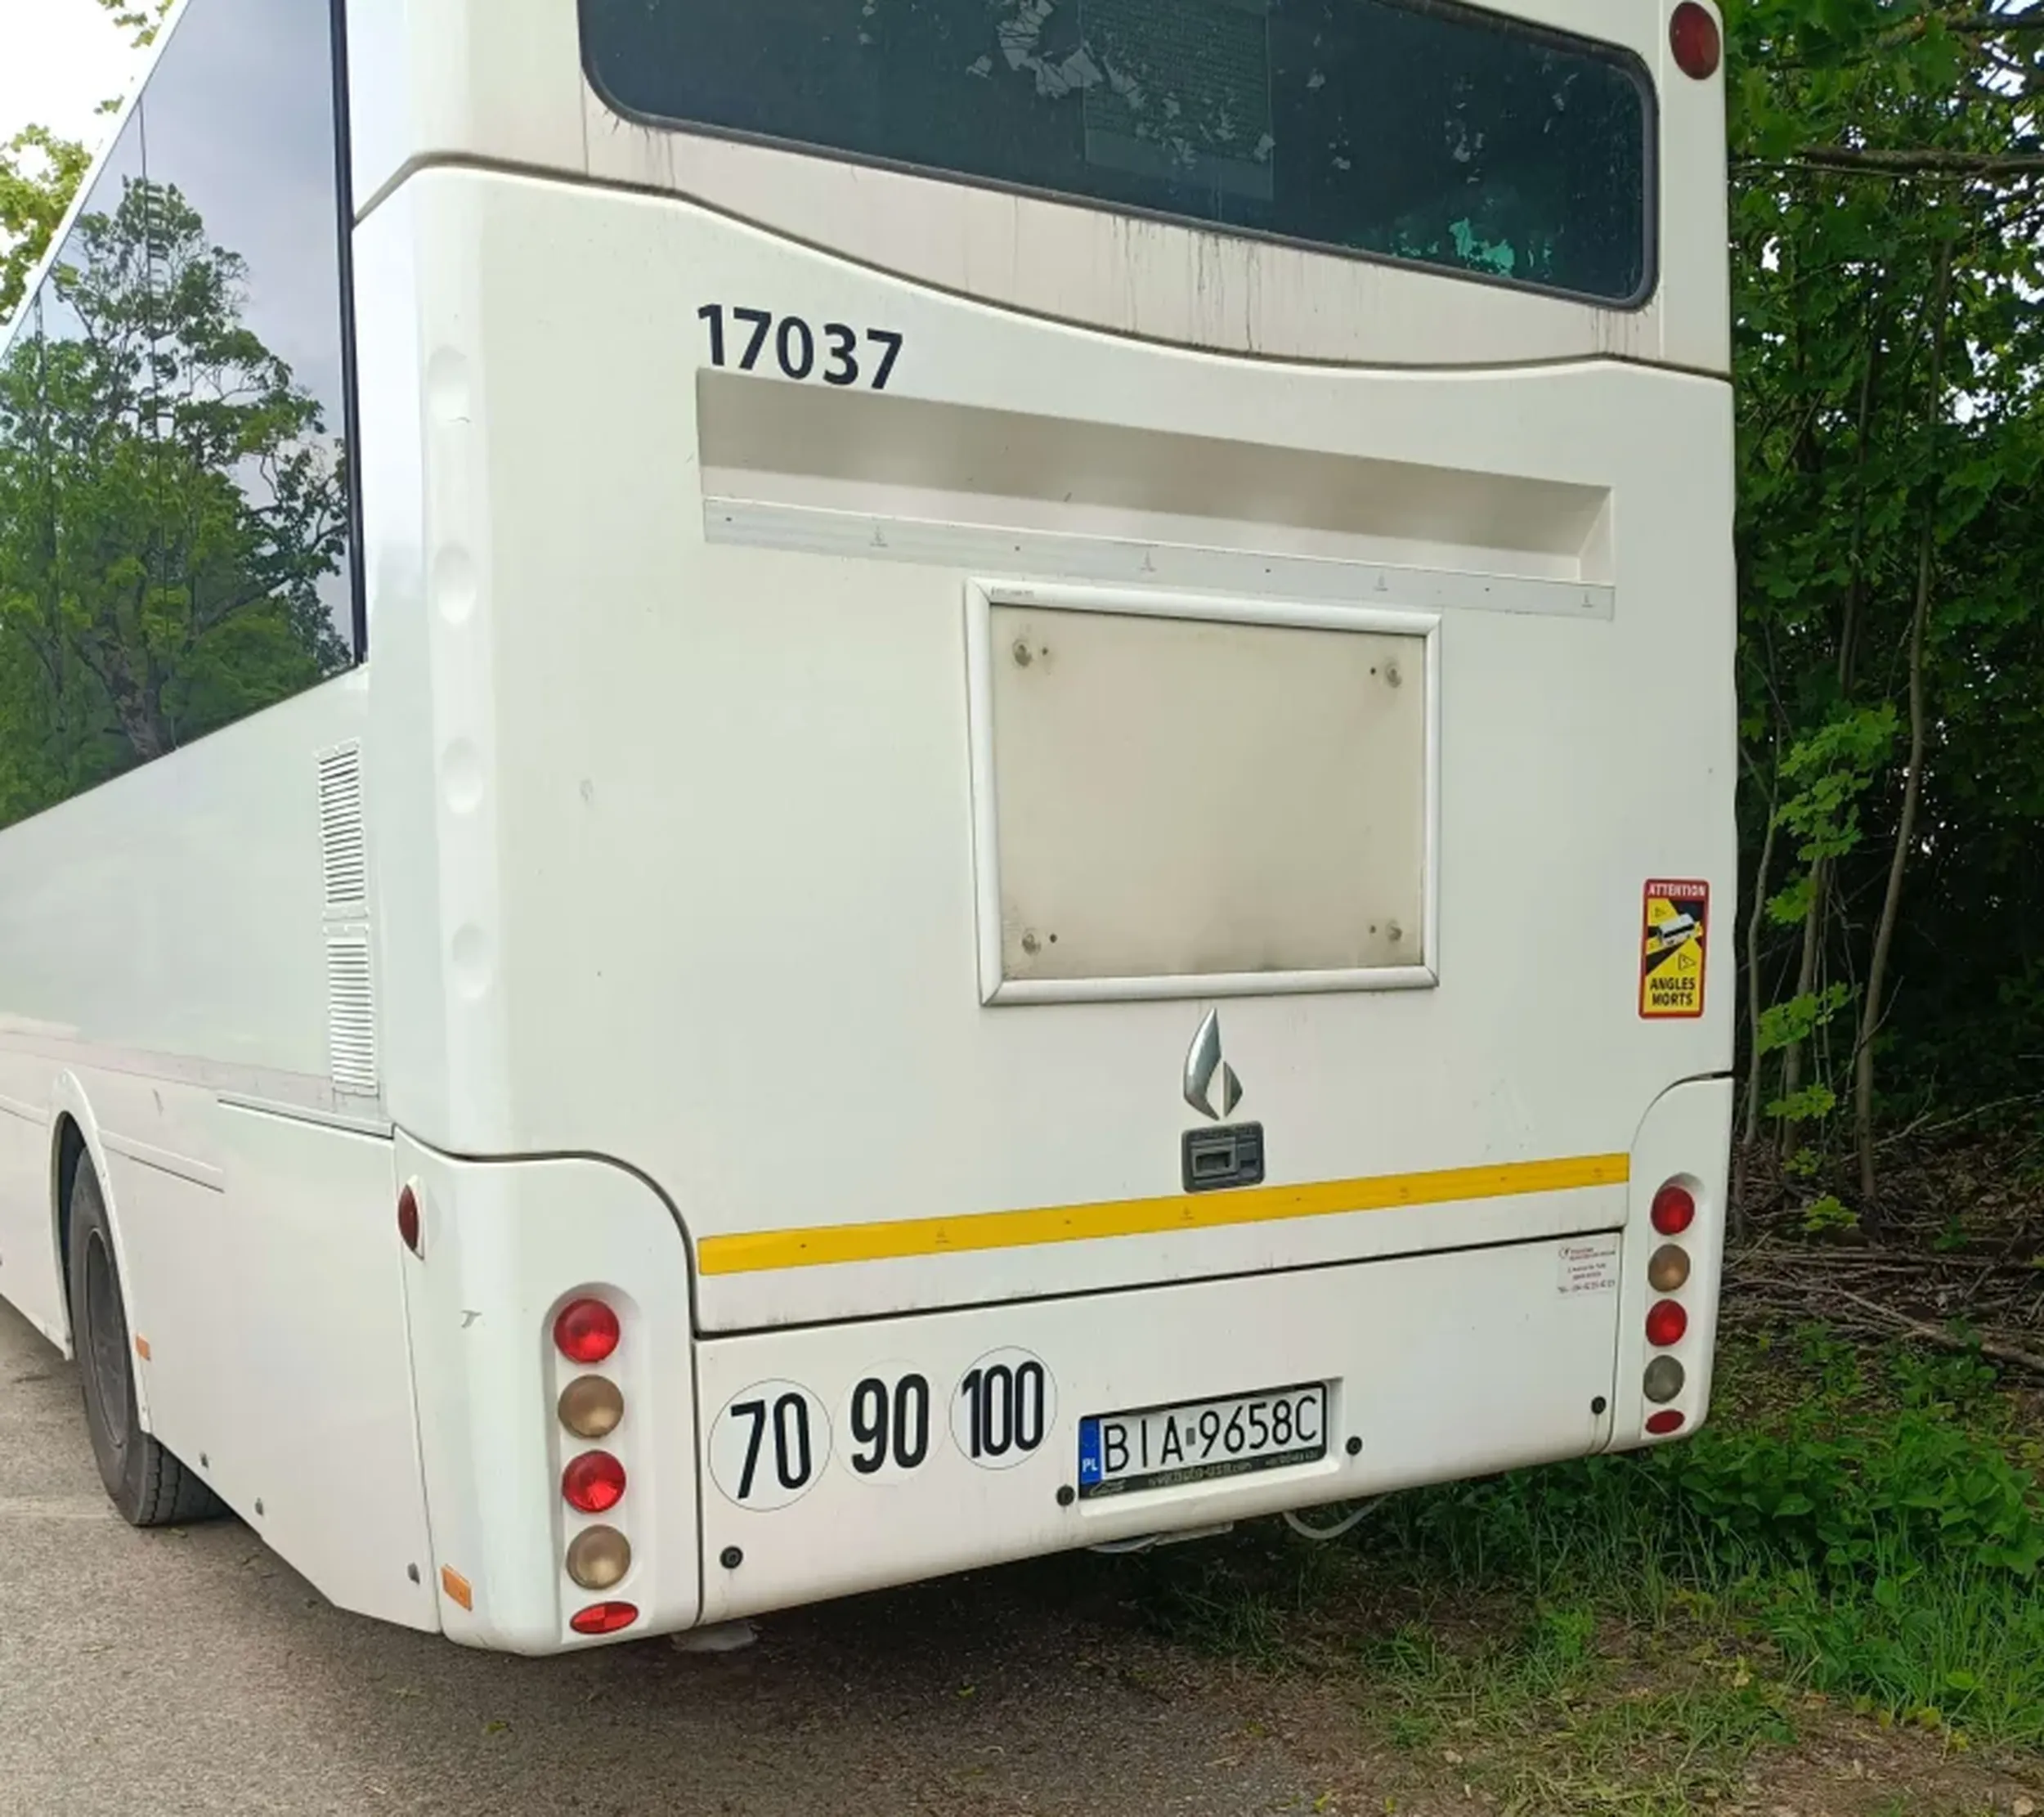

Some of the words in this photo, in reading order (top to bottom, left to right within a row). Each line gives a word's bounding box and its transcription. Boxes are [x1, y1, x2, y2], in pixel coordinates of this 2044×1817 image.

[697, 303, 903, 389] 17037
[1647, 883, 1706, 896] ATTENTION
[1650, 976, 1696, 990] ANGLES
[1652, 993, 1693, 1007] MORTS
[851, 1373, 930, 1474] 90
[961, 1360, 1045, 1459] 100
[730, 1393, 812, 1499] 70
[1082, 1458, 1098, 1472] PL
